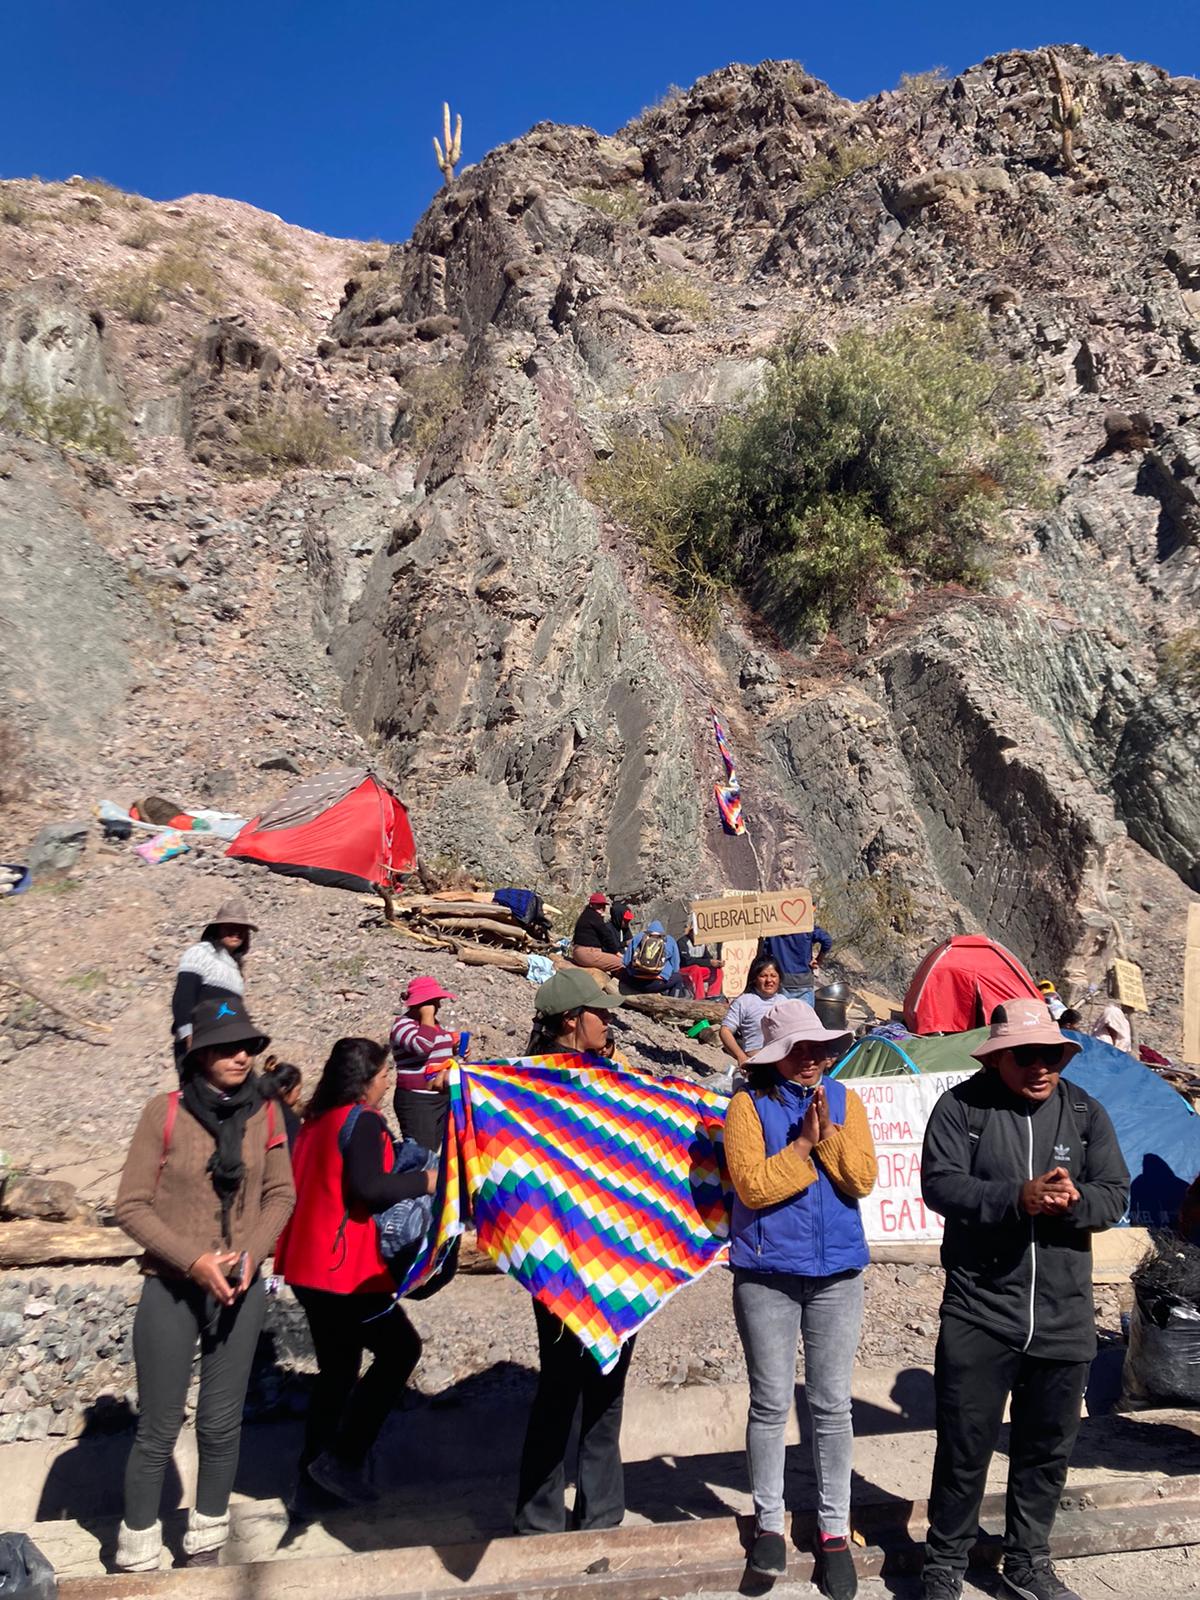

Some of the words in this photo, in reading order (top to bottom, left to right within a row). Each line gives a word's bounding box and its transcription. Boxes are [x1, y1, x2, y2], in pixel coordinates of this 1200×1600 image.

[696, 904, 778, 932] QUEBRALEÑA
[725, 947, 744, 961] NO
[935, 1074, 973, 1094] ABA
[852, 1086, 894, 1104] BAJO
[869, 1121, 913, 1141] ORMA
[876, 1152, 921, 1189] ORA
